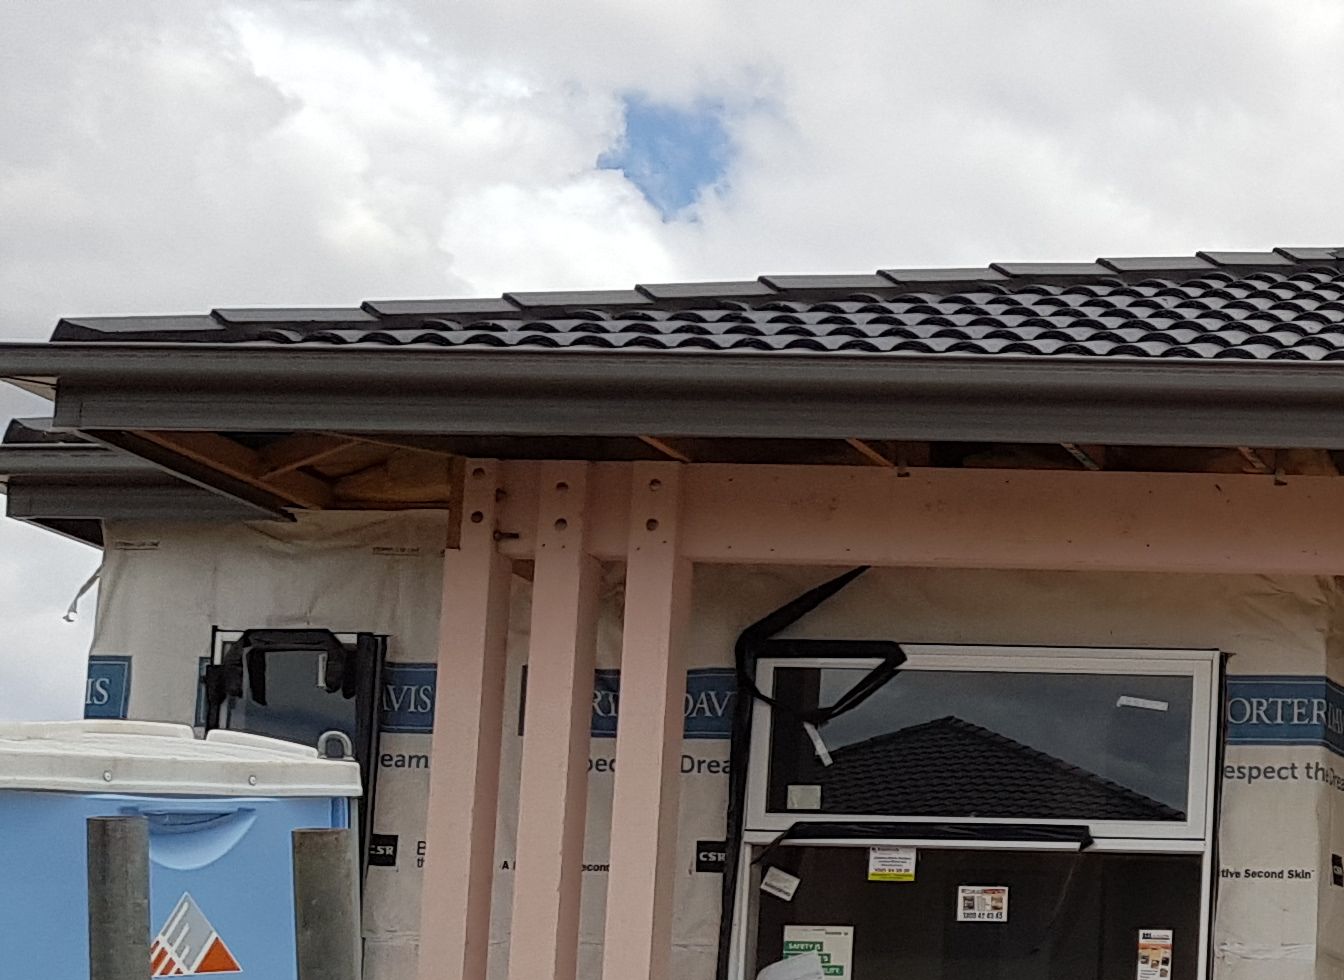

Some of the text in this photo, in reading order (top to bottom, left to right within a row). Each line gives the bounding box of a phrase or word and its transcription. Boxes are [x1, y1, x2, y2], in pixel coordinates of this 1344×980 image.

[1226, 698, 1327, 725] ORTER
[1223, 763, 1299, 784] espect
[1244, 869, 1284, 879] Second
